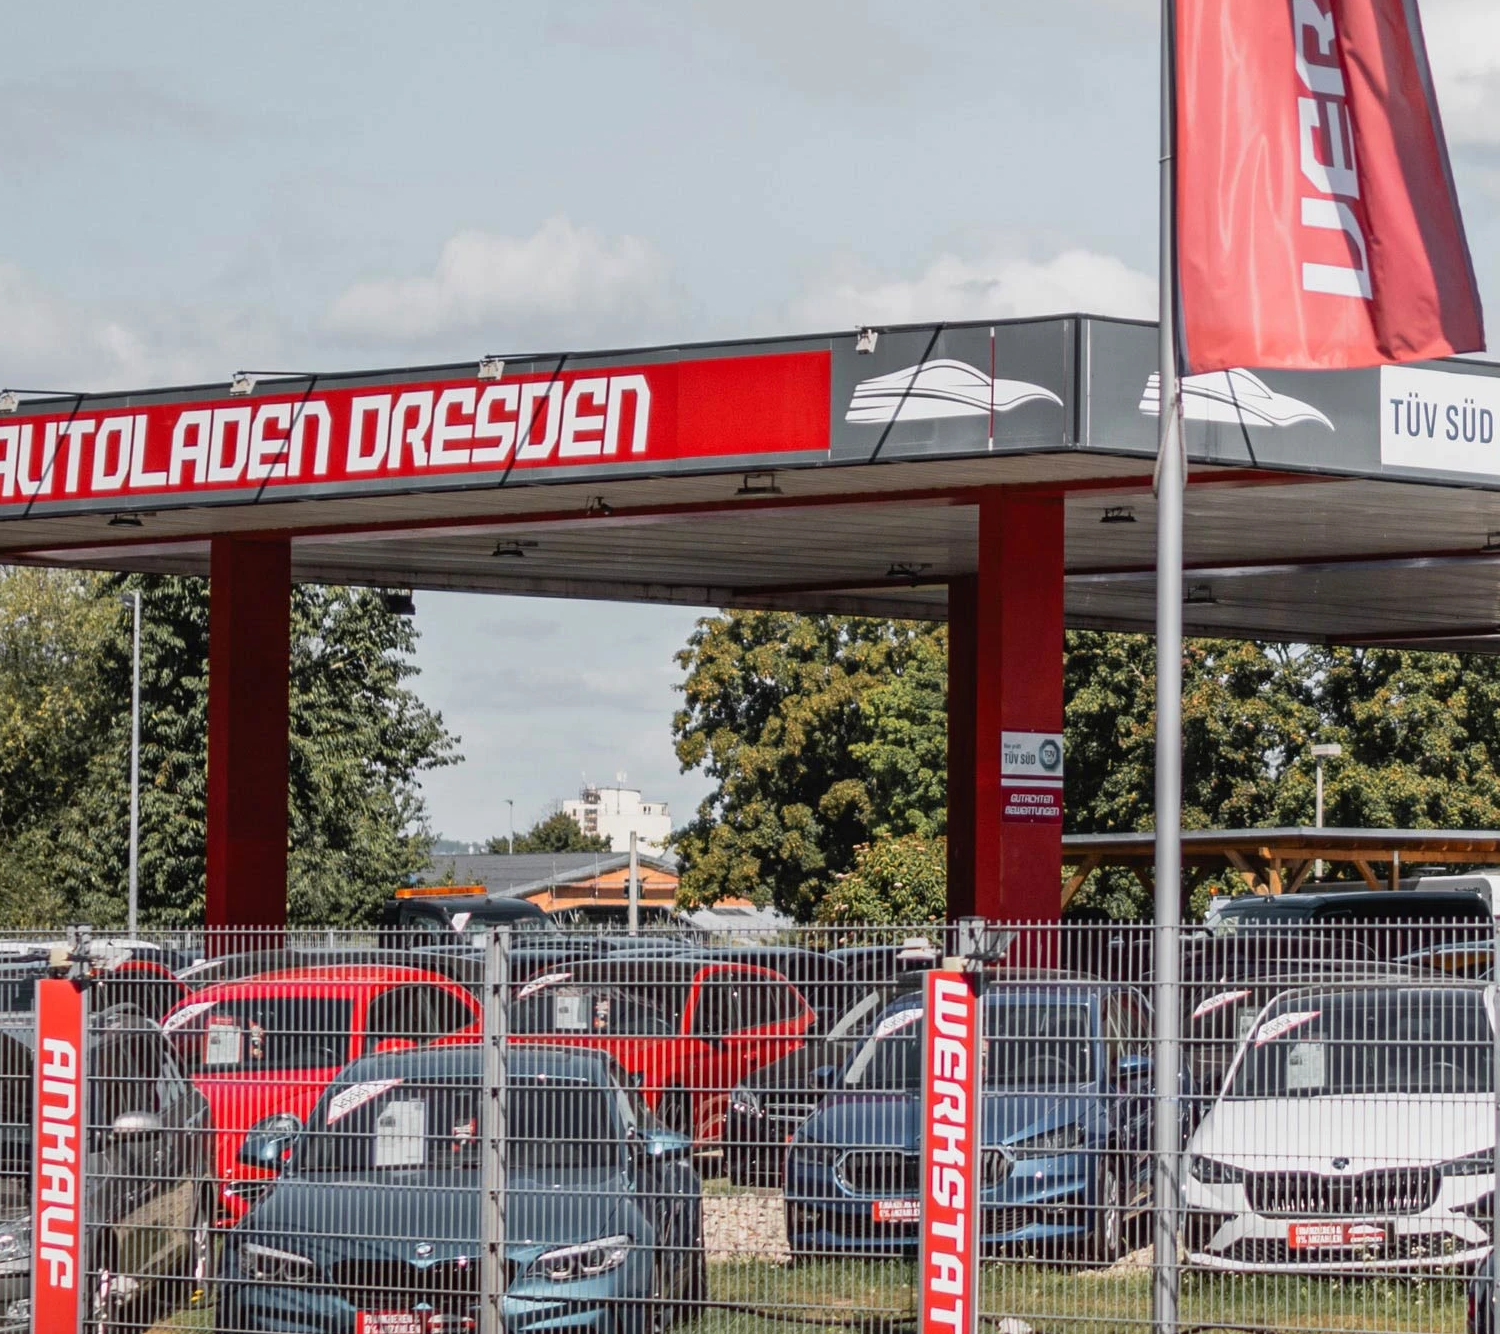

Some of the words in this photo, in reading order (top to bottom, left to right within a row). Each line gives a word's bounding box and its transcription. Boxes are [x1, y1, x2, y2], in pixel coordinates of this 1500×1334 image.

[345, 373, 652, 472] DRESDEN
[1390, 392, 1438, 438] TÜV
[1445, 398, 1494, 444] SÜD
[1004, 751, 1019, 764] TÜV
[1020, 752, 1036, 765] SÜD
[41, 1038, 78, 1290] ANKAUF
